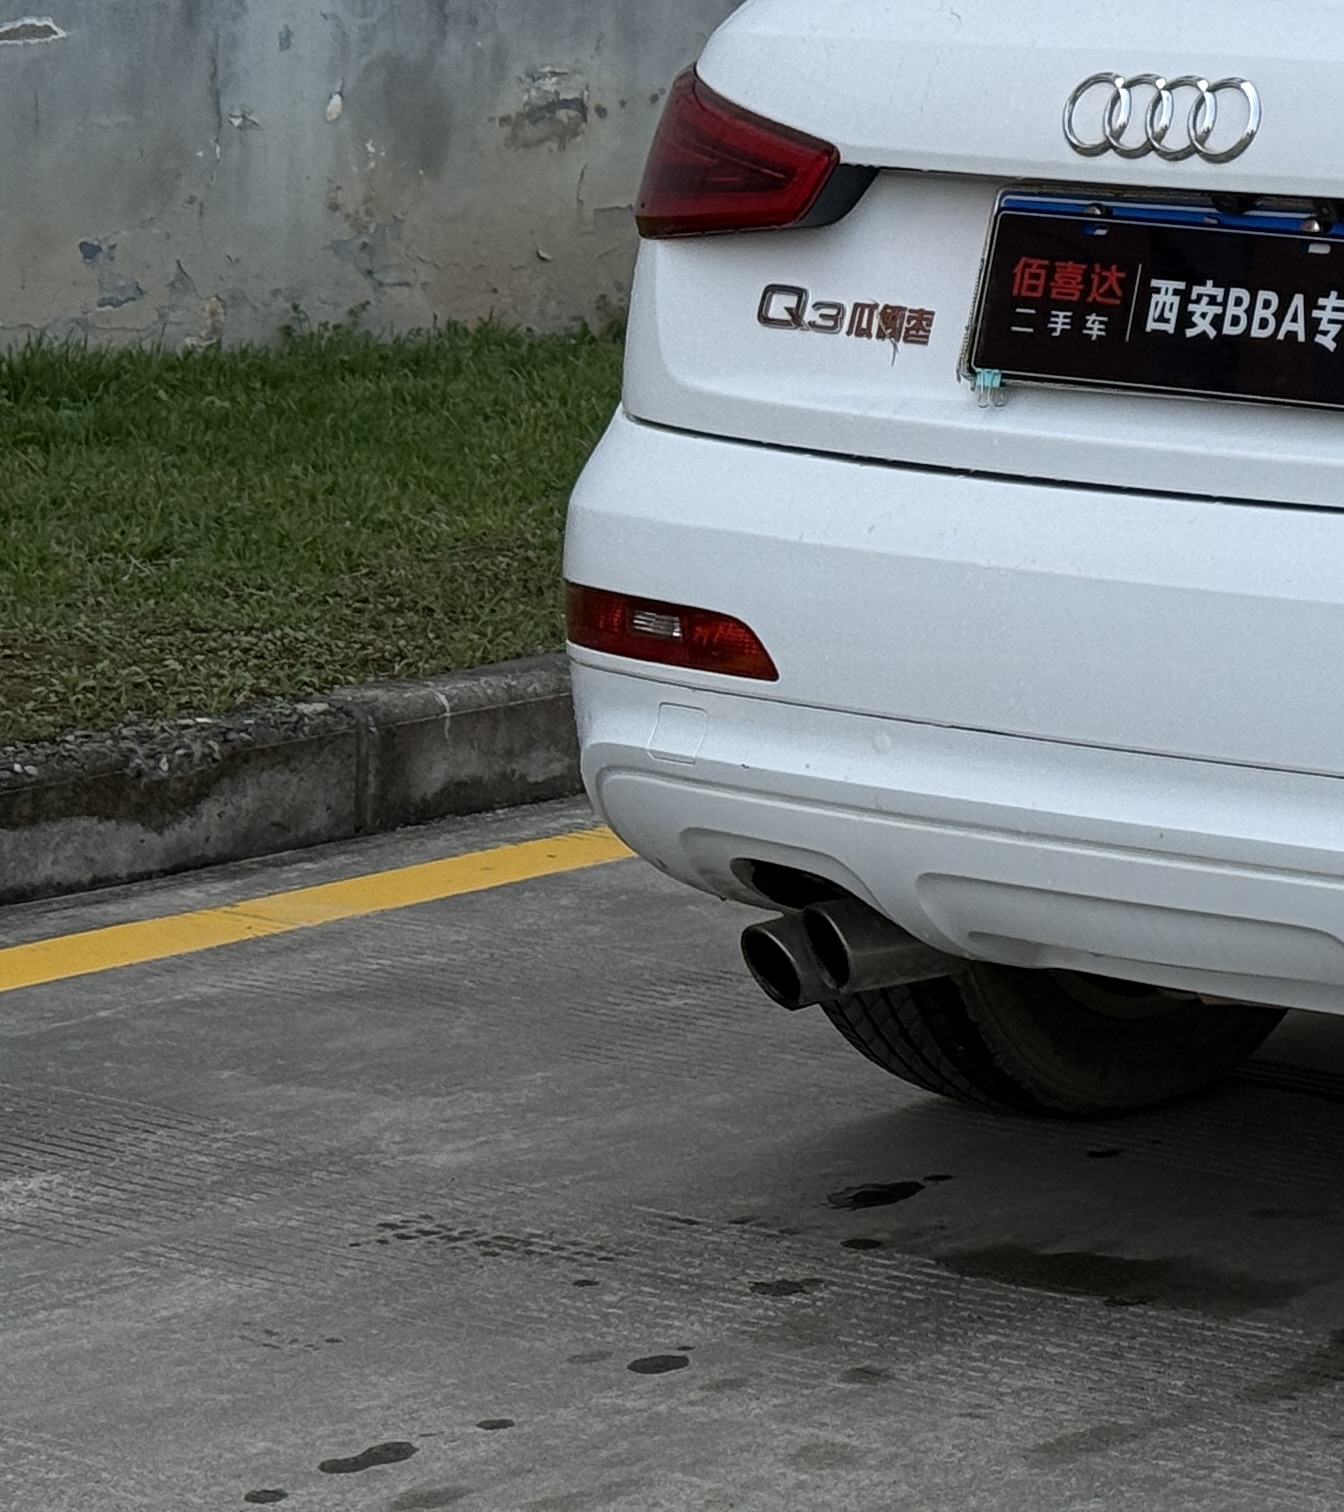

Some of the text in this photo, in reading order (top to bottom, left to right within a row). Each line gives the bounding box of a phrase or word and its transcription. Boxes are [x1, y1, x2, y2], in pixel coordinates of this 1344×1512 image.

[1011, 256, 1126, 305] 佰喜达
[757, 283, 847, 335] Q3
[1010, 308, 1109, 341] 二手车
